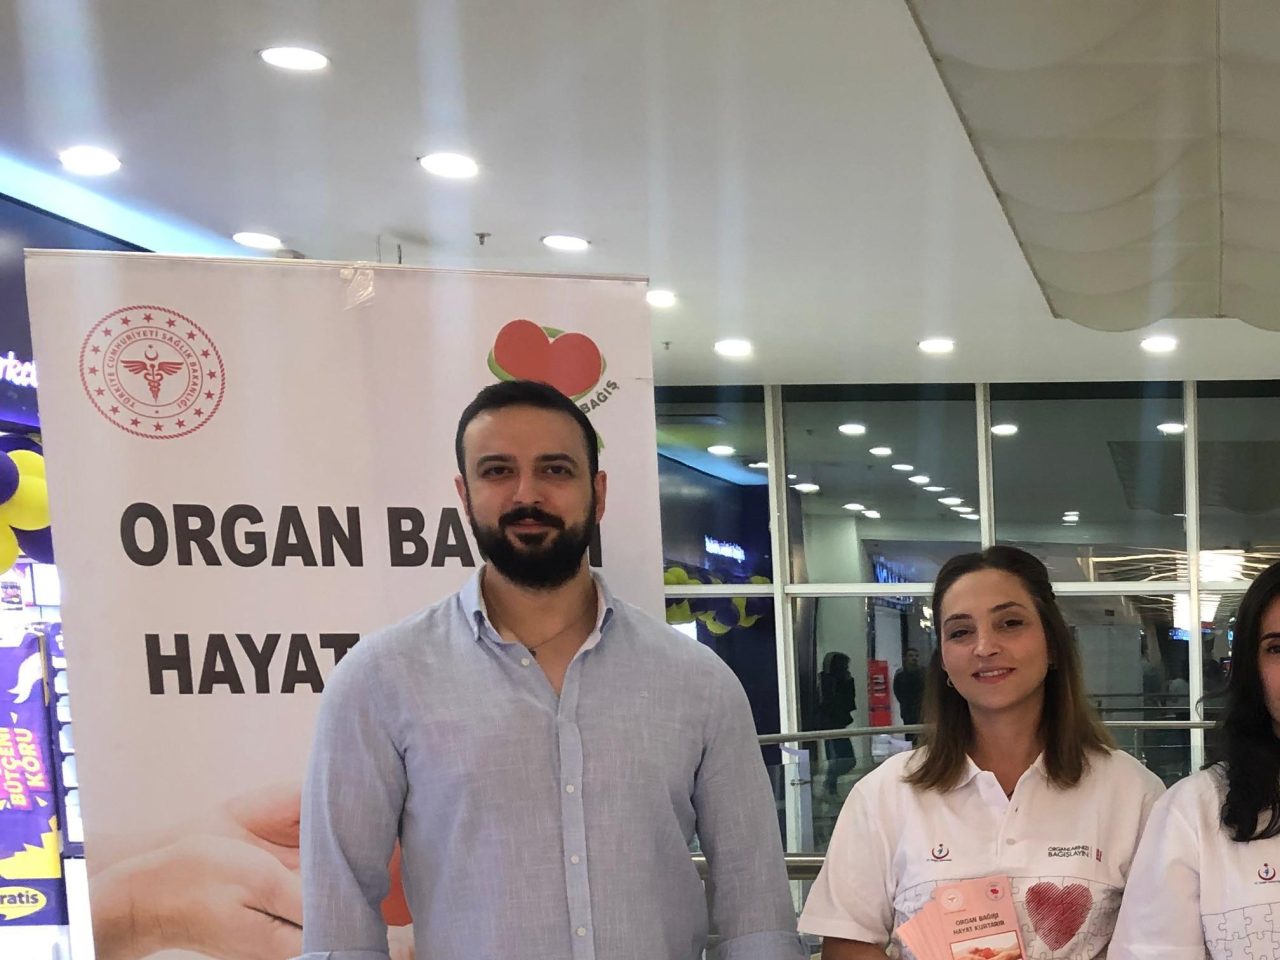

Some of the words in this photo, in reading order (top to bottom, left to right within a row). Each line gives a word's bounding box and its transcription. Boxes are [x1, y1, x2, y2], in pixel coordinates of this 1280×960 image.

[161, 332, 194, 360] SAĞLIK
[579, 379, 620, 415] BAĞIŞ
[120, 501, 364, 568] ORGAN
[144, 633, 361, 695] HAYAT
[14, 727, 46, 788] KORU
[0, 890, 39, 906] ratis
